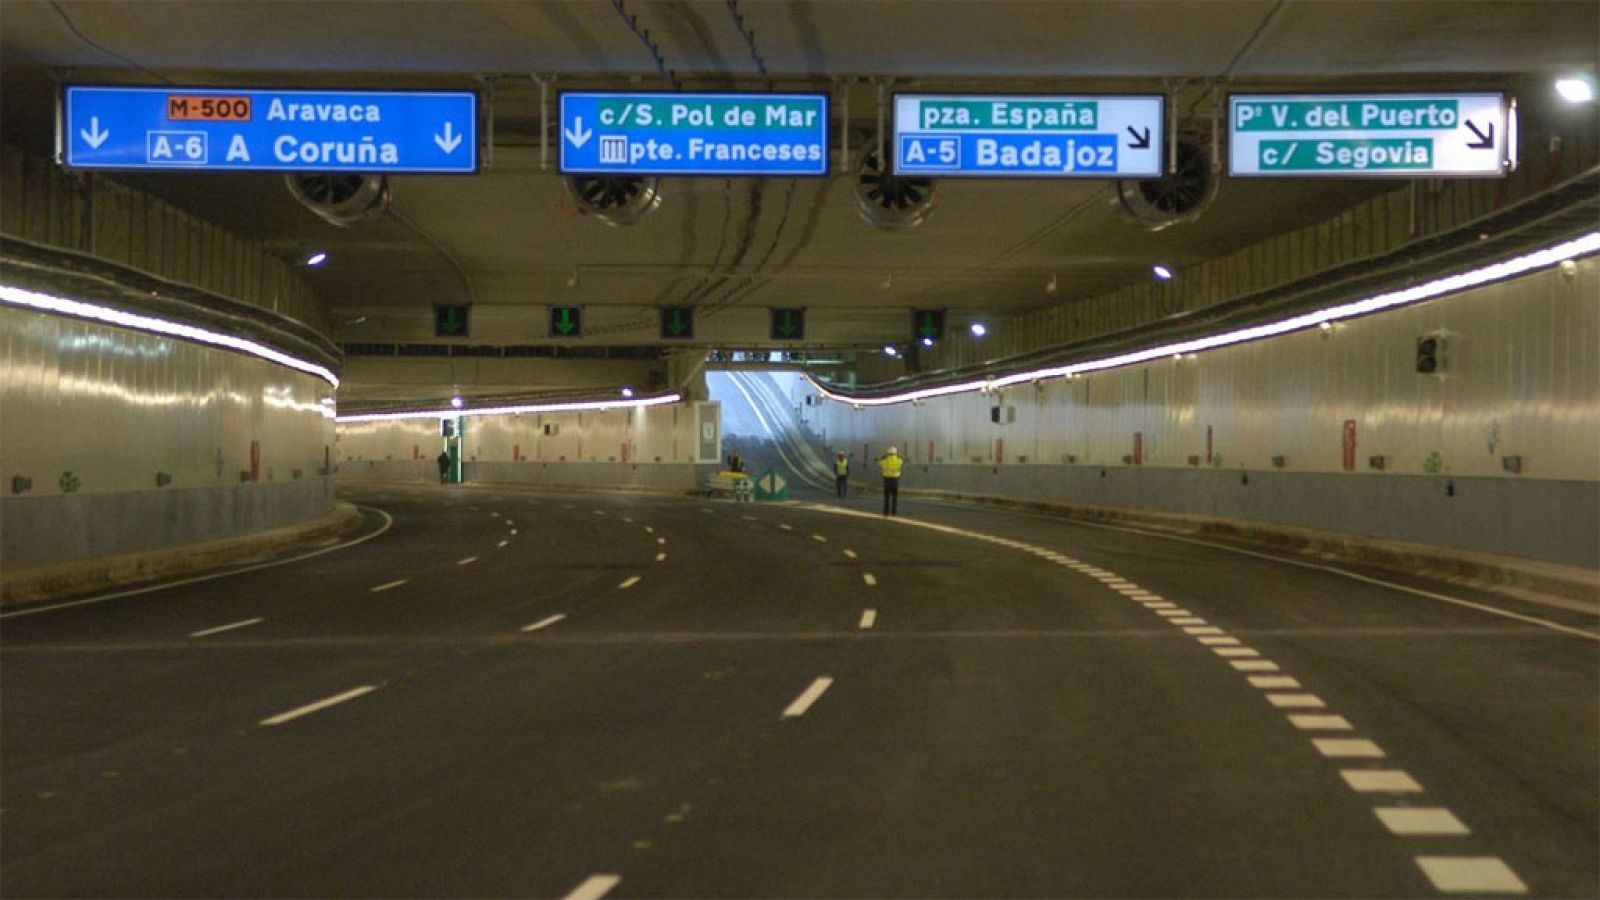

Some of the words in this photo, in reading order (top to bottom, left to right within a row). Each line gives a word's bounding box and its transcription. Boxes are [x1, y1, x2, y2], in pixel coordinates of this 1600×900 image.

[170, 98, 248, 119] M-500
[267, 99, 381, 122] Aravaca
[672, 105, 714, 126] Pol
[724, 106, 756, 126] de
[765, 105, 817, 126] Mar
[924, 105, 980, 129] pza.
[992, 102, 1095, 129] España
[1272, 106, 1298, 127] V.
[1305, 105, 1351, 127] del
[1361, 104, 1457, 127] Puerto
[152, 134, 204, 159] A-6
[226, 134, 251, 162] A
[274, 133, 399, 164] Coruña
[630, 140, 682, 163] pte.
[688, 138, 821, 161] Franceses
[905, 140, 957, 163] A-5
[977, 139, 1114, 173] Badajoz
[1263, 143, 1298, 165] c/
[1316, 141, 1430, 169] Segovia
